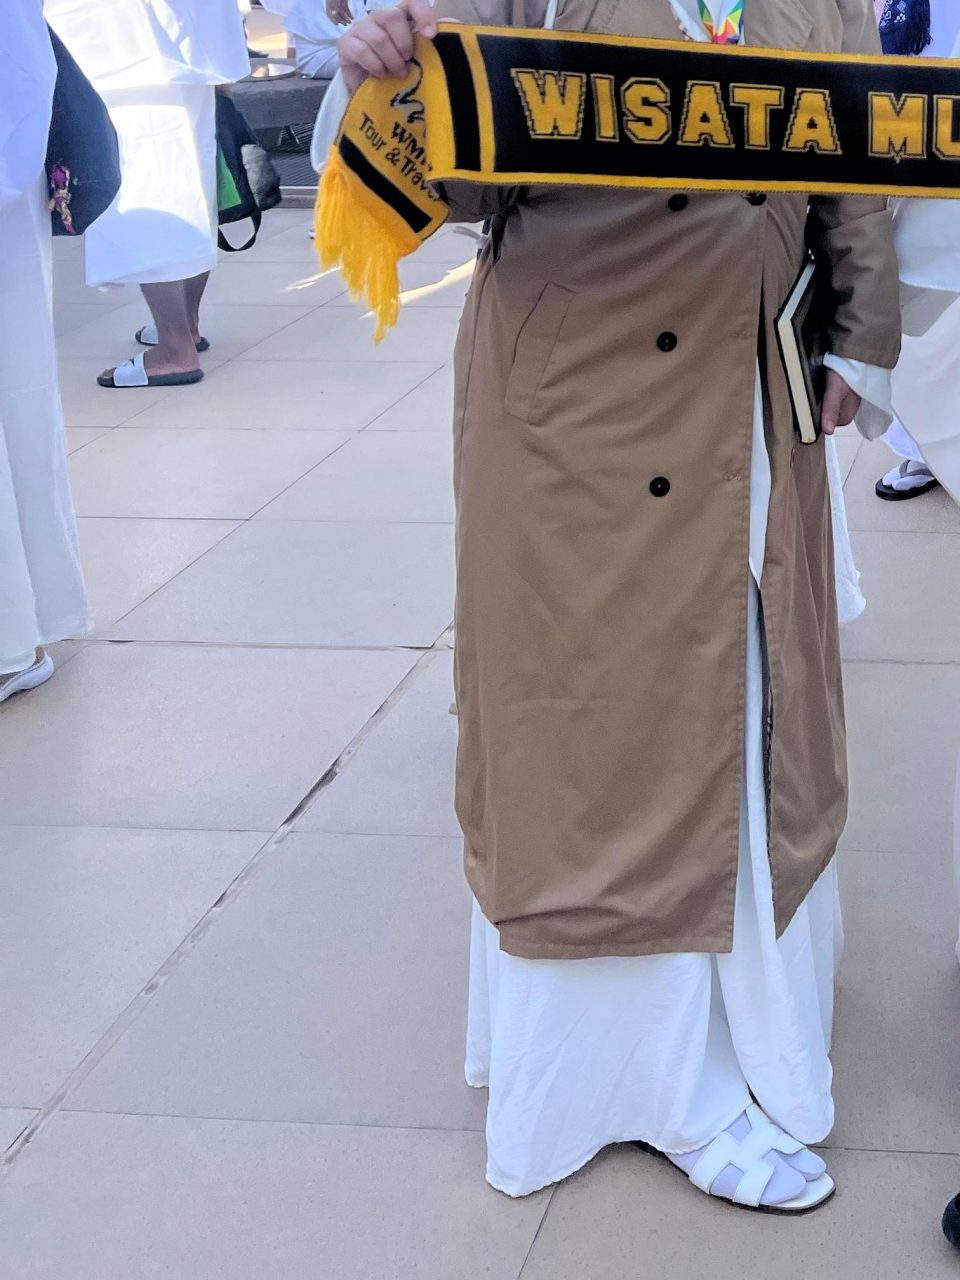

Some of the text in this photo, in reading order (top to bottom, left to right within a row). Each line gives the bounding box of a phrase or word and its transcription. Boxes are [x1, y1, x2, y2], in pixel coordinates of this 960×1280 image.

[359, 112, 387, 151] Tour
[385, 147, 401, 167] &
[510, 68, 843, 155] WISATA
